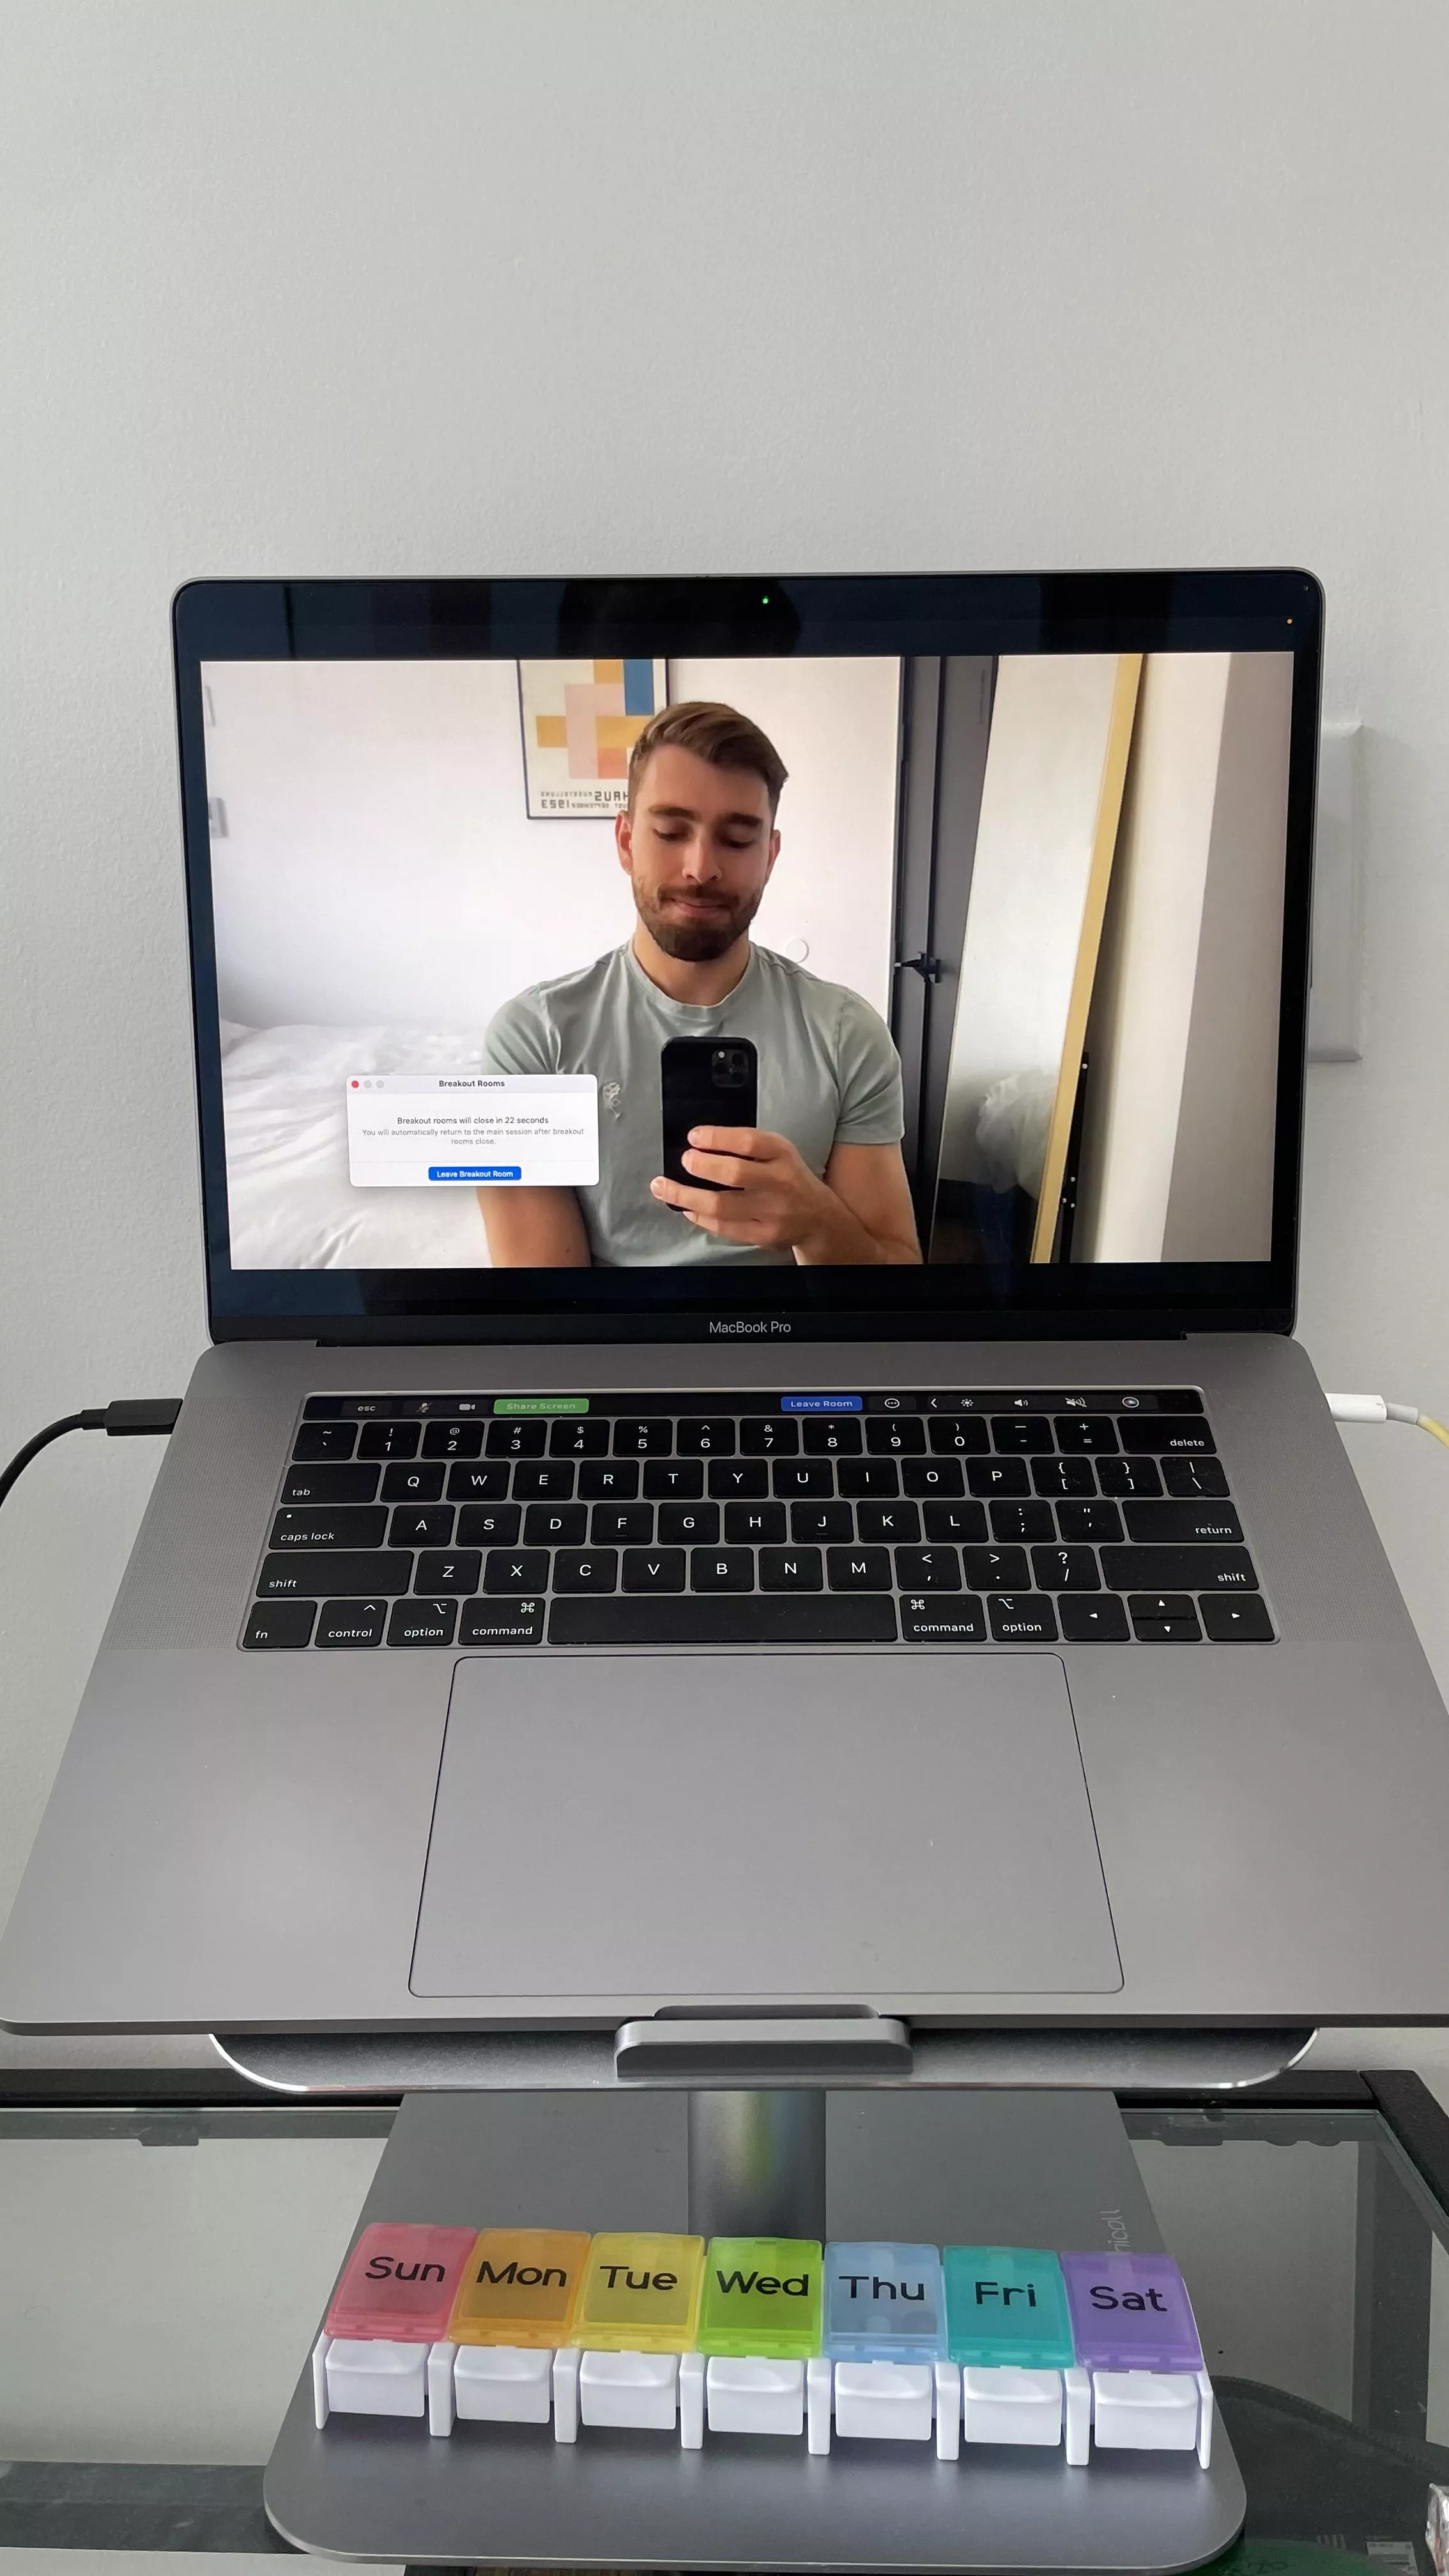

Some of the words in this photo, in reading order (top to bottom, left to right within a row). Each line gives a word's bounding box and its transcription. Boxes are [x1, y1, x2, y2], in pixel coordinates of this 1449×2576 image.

[710, 1321, 767, 1333] MacBook
[771, 1321, 791, 1332] Pro
[385, 1442, 391, 1451] 1
[447, 1441, 457, 1450] 2
[511, 1440, 520, 1449] 3
[574, 1439, 584, 1448] 4
[638, 1439, 647, 1448] 5
[701, 1439, 710, 1448] 6
[765, 1438, 773, 1447] 7
[828, 1438, 837, 1446] 8
[891, 1437, 900, 1446] 9
[955, 1437, 965, 1446] 0
[1059, 1462, 1065, 1474] {
[1123, 1462, 1130, 1474] }
[408, 1476, 419, 1487] Q
[471, 1476, 487, 1485] W
[539, 1475, 548, 1485] E
[604, 1475, 613, 1484] R
[668, 1474, 678, 1483] T
[733, 1473, 743, 1483] Y
[797, 1473, 808, 1483] U
[866, 1472, 869, 1482] I
[927, 1472, 938, 1482] O
[992, 1471, 1002, 1481] P
[1062, 1479, 1068, 1489] [
[1128, 1478, 1134, 1489] ]
[1192, 1478, 1201, 1489] \
[416, 1520, 427, 1530] A
[484, 1519, 494, 1529] S
[550, 1519, 561, 1529] D
[618, 1518, 627, 1528] F
[684, 1517, 694, 1528] G
[750, 1517, 761, 1527] H
[818, 1516, 825, 1526] J
[883, 1515, 894, 1526] K
[950, 1515, 960, 1526] L
[1195, 1524, 1232, 1533] return
[923, 1554, 931, 1563] <
[990, 1554, 999, 1562] >
[1059, 1552, 1067, 1563] ?
[443, 1567, 454, 1577] Z
[511, 1565, 523, 1576] X
[580, 1565, 591, 1575] C
[648, 1564, 659, 1575] V
[717, 1563, 727, 1574] B
[785, 1563, 796, 1574] N
[852, 1563, 866, 1573] M
[1065, 1568, 1069, 1581] /
[1218, 1573, 1246, 1581] shift
[328, 1629, 372, 1637] control
[404, 1628, 443, 1637] option
[473, 1627, 532, 1635] command
[1003, 1623, 1041, 1632] option
[365, 2257, 445, 2282] Sun
[476, 2261, 567, 2287] Mon
[600, 2266, 677, 2290] Tue
[717, 2271, 808, 2296] Wed
[839, 2276, 924, 2301] Thu
[976, 2281, 1036, 2307] Fri
[1090, 2286, 1167, 2312] Sat
